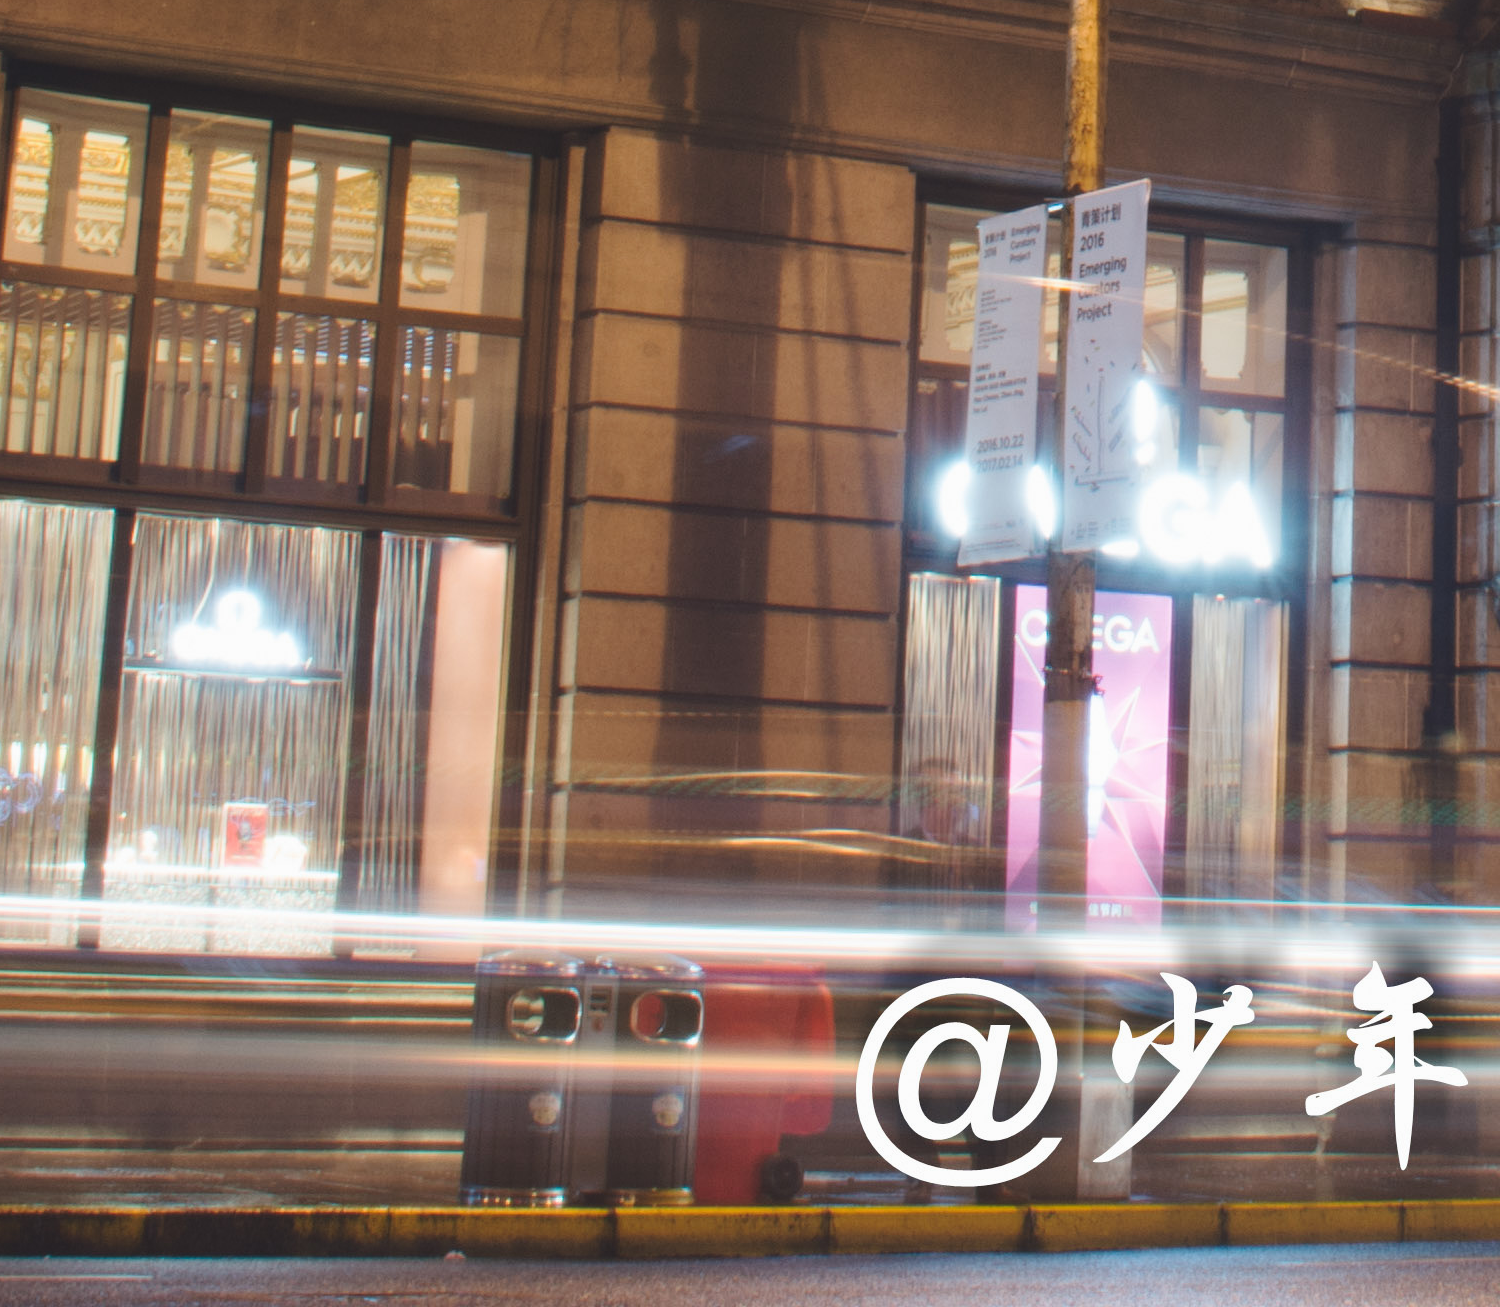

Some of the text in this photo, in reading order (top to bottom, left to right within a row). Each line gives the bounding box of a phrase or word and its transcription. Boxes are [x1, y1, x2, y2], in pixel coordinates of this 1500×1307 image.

[1011, 223, 1041, 237] Emerging
[1010, 237, 1036, 251] Curators
[1080, 231, 1105, 253] 2016
[1009, 251, 1031, 265] Project
[1079, 256, 1128, 279] Emerging
[1077, 280, 1121, 300] Cutors
[1076, 301, 1112, 322] Project
[976, 433, 1024, 454] 2016.10.22
[976, 453, 1024, 474] 2017.02.14
[1020, 609, 1160, 653] OEGA
